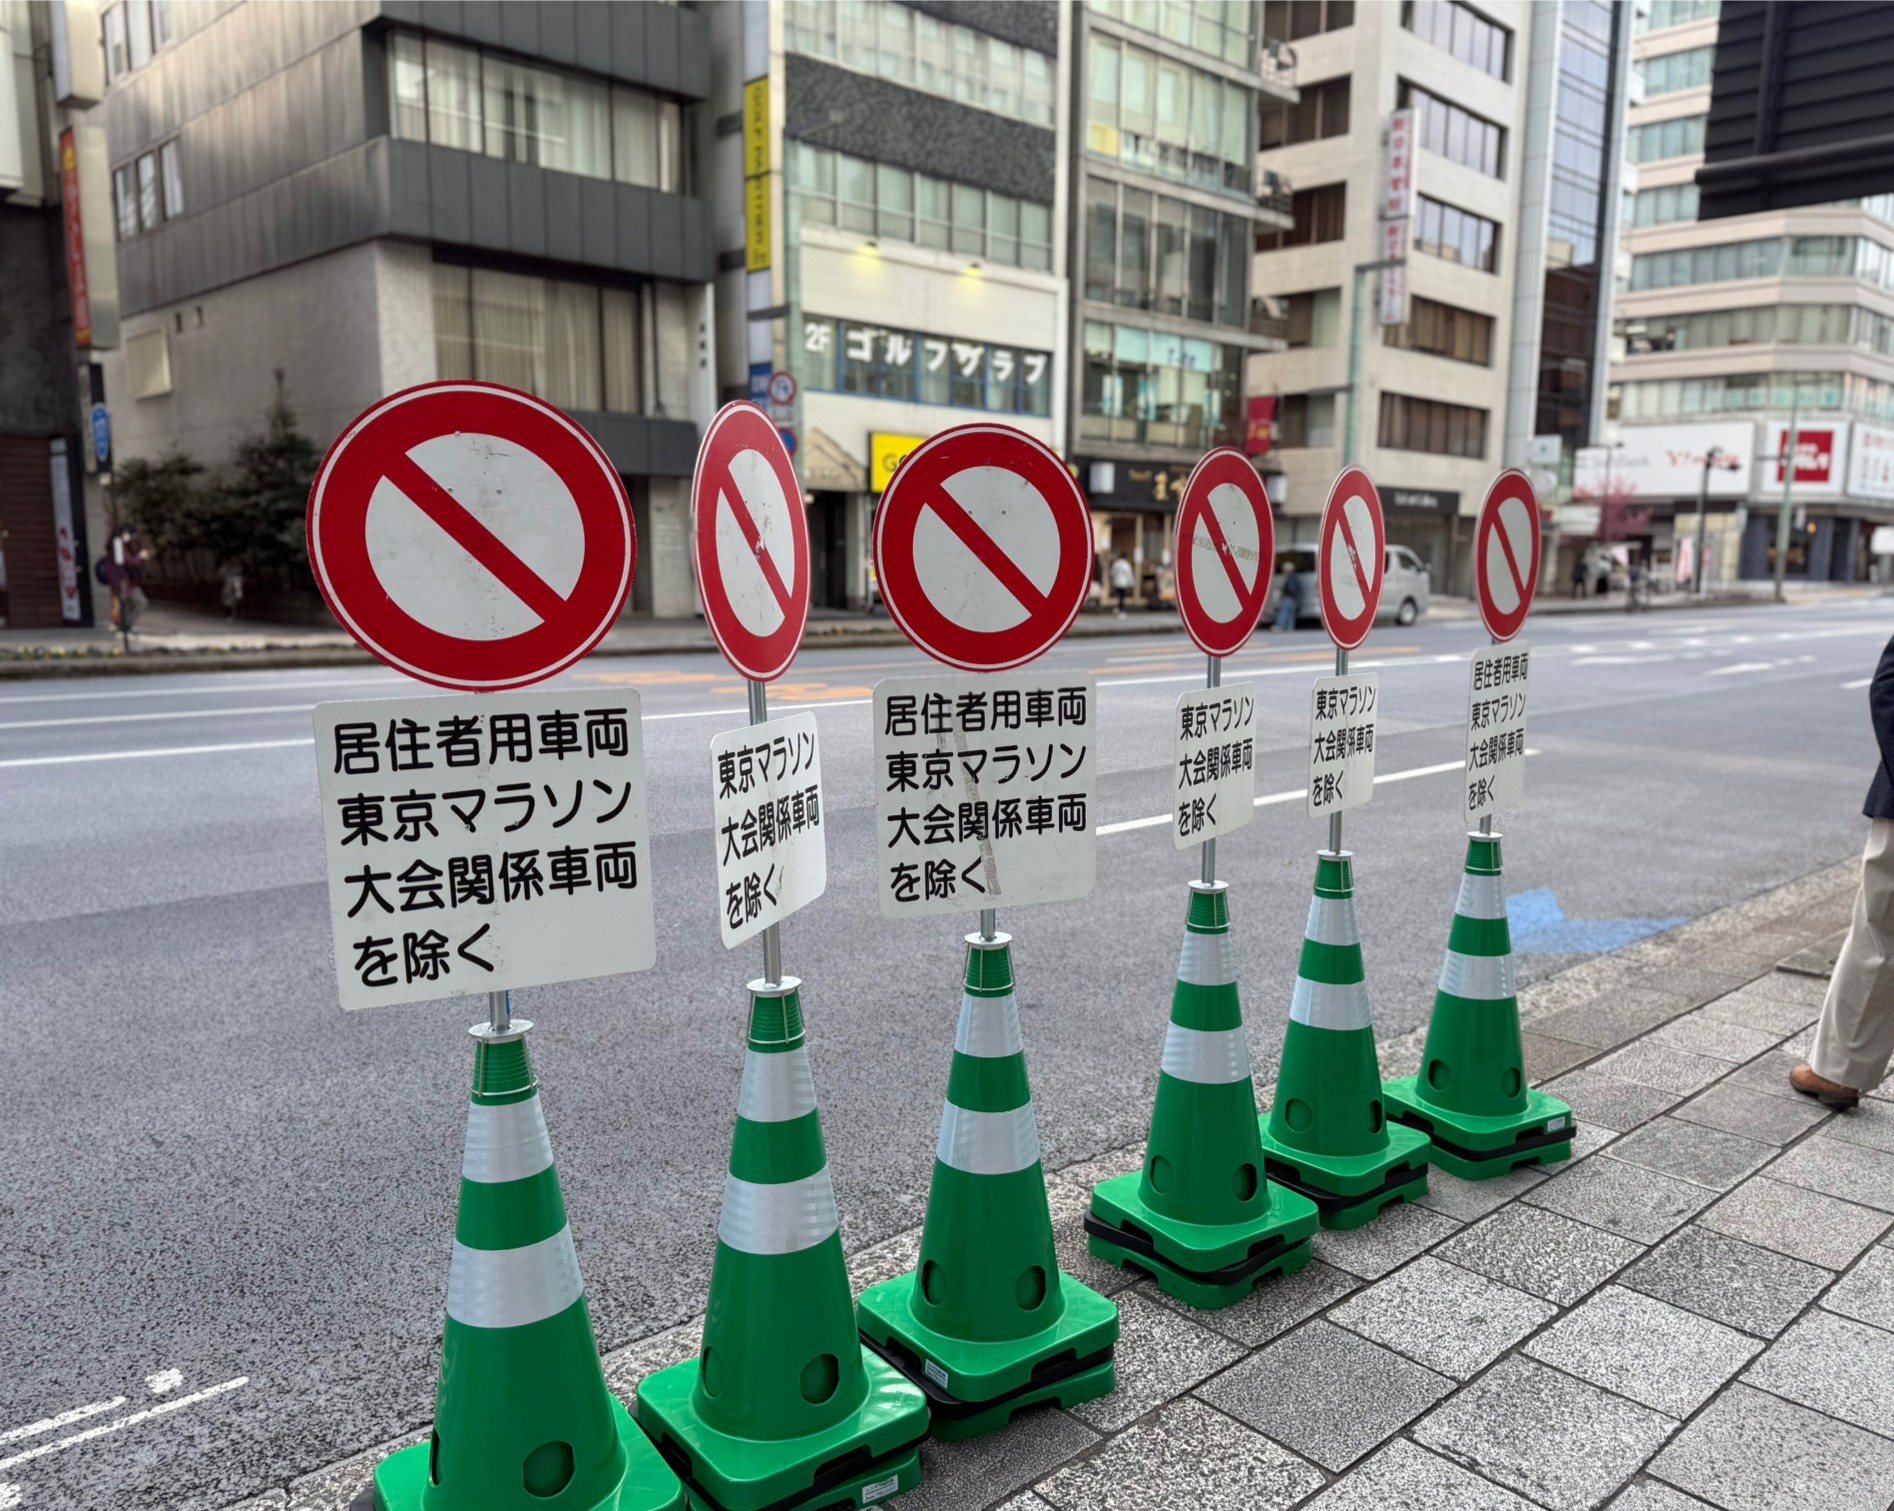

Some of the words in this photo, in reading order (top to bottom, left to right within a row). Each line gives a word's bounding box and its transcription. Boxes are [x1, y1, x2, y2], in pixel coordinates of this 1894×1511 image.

[804, 321, 831, 352] 2F
[1473, 653, 1529, 691] 居住者用車両
[885, 686, 1088, 736] 居住者用車両
[1180, 696, 1255, 741] 東京マラソン
[1315, 685, 1377, 721] 東京マラソン
[1470, 693, 1527, 731] 東京マラソン
[333, 707, 630, 774] 居住者用車両
[1178, 737, 1254, 790] 大会関係車両
[1313, 723, 1375, 764] 大会関係車両
[1468, 727, 1525, 772] 大会関係車両
[717, 731, 817, 800] 東京マラソン
[886, 743, 1087, 792] 東京マラソン
[1312, 770, 1344, 807] を除く
[337, 779, 632, 846] 東京マラソン
[1178, 792, 1217, 837] を除く
[1468, 774, 1496, 811] を除く
[720, 784, 821, 867] 大会関係車両
[887, 793, 1087, 848] 大会関係車両
[343, 841, 637, 918] 大会関係車両
[725, 862, 778, 930] を除く
[890, 855, 986, 902] を除く
[353, 923, 494, 987] を除く
